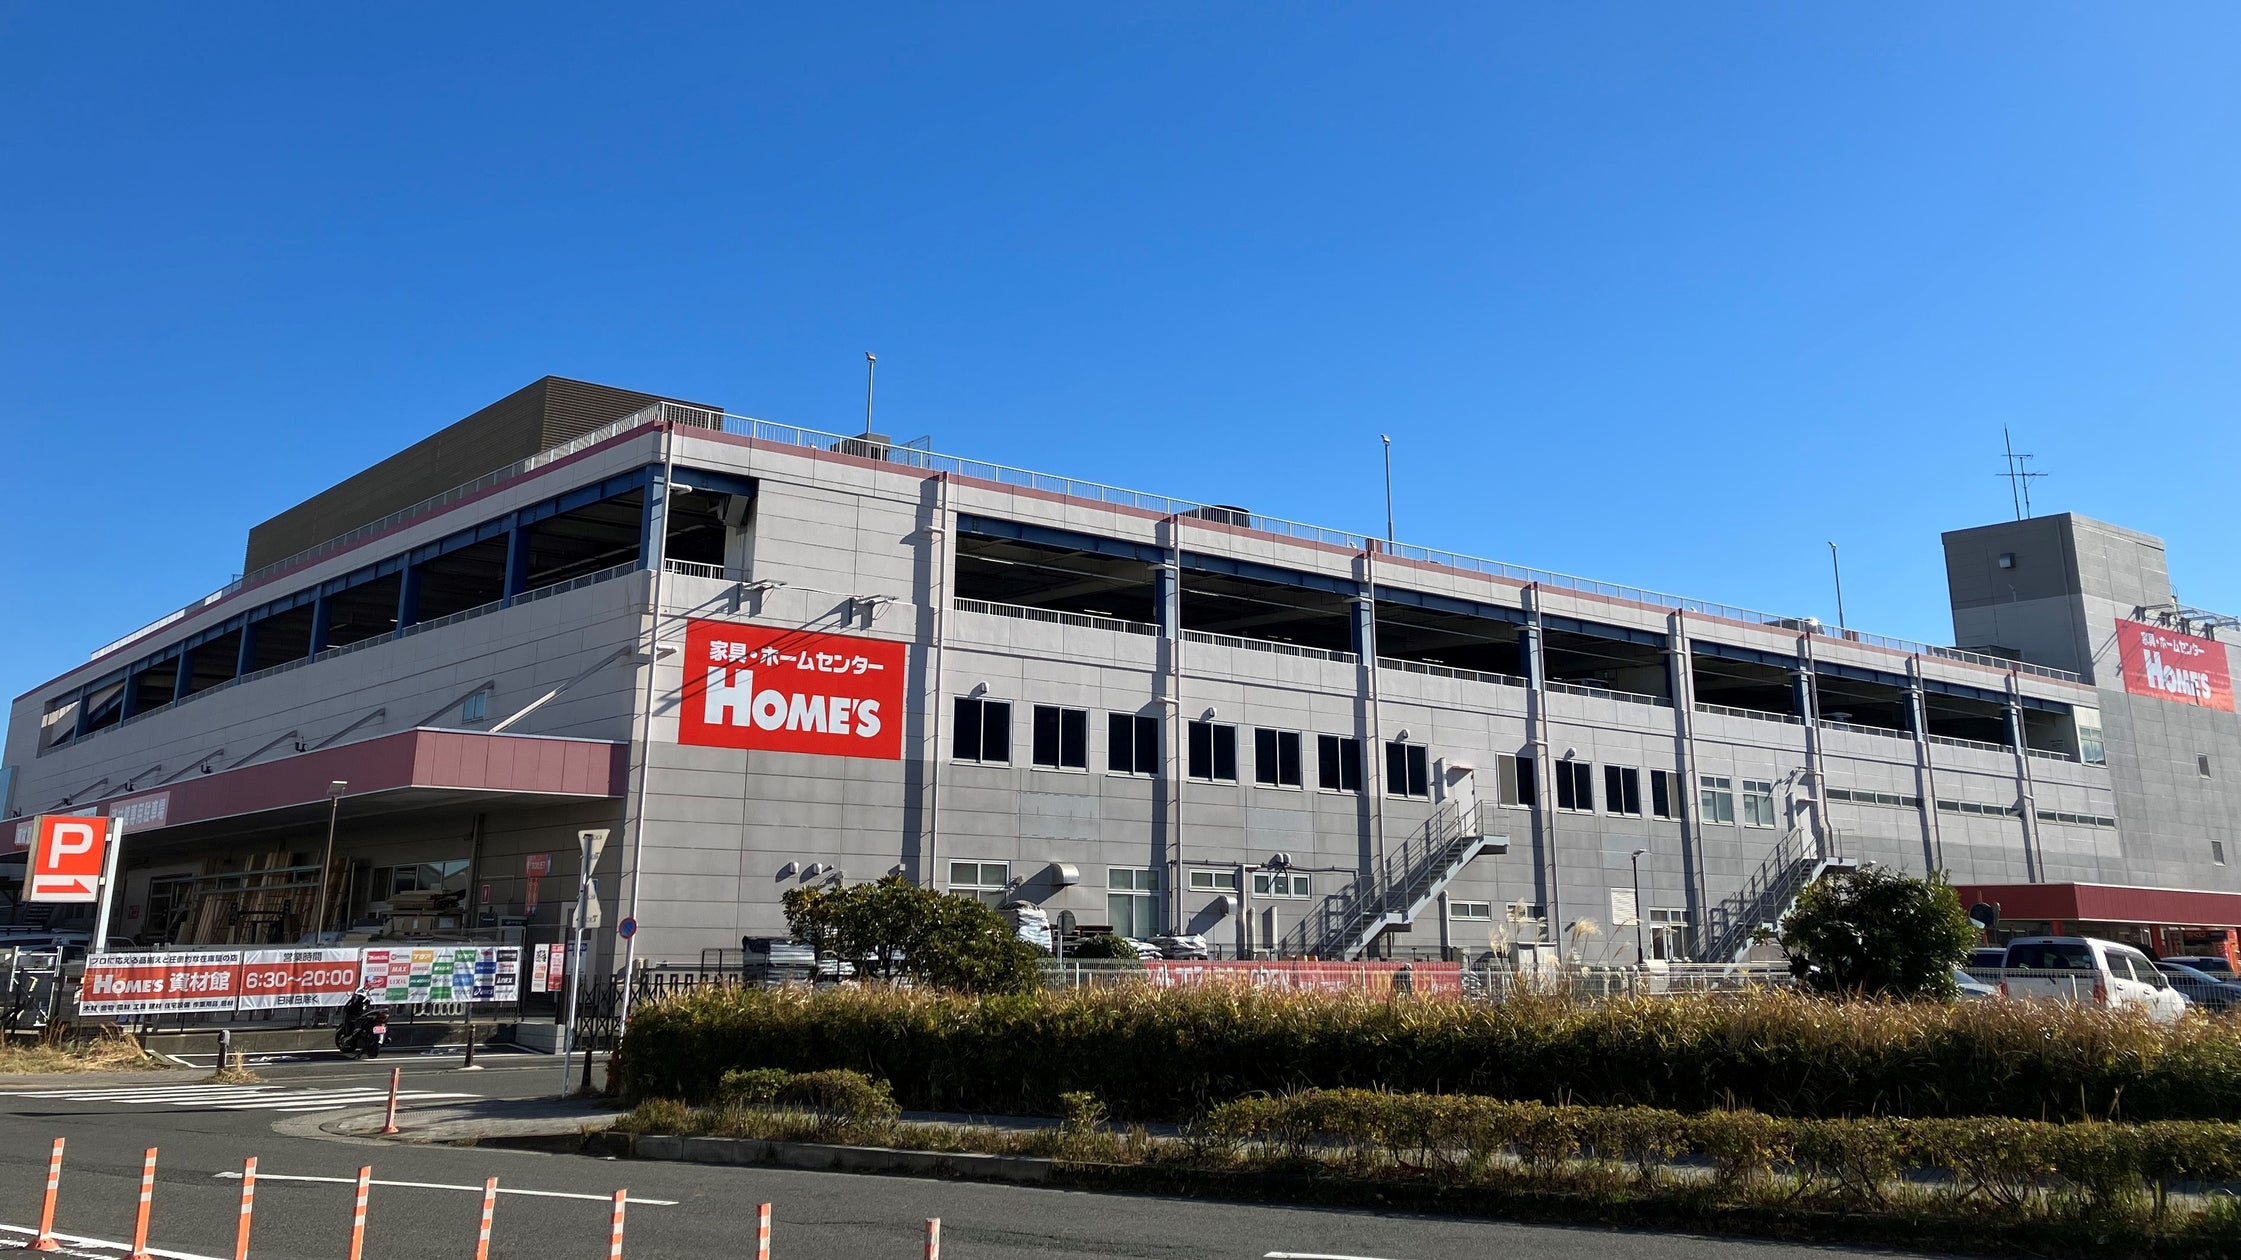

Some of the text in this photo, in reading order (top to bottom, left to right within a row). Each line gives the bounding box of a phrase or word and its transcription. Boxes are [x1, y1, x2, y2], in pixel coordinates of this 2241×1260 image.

[709, 640, 884, 675] 家具・ホームセンター
[2141, 631, 2205, 657] 家具・ホームセンター
[2143, 648, 2211, 700] HOME'S
[703, 665, 882, 738] HOME'S
[48, 823, 94, 869] P
[283, 952, 323, 962] 営業時間
[92, 971, 231, 995] HOME'S 資材館
